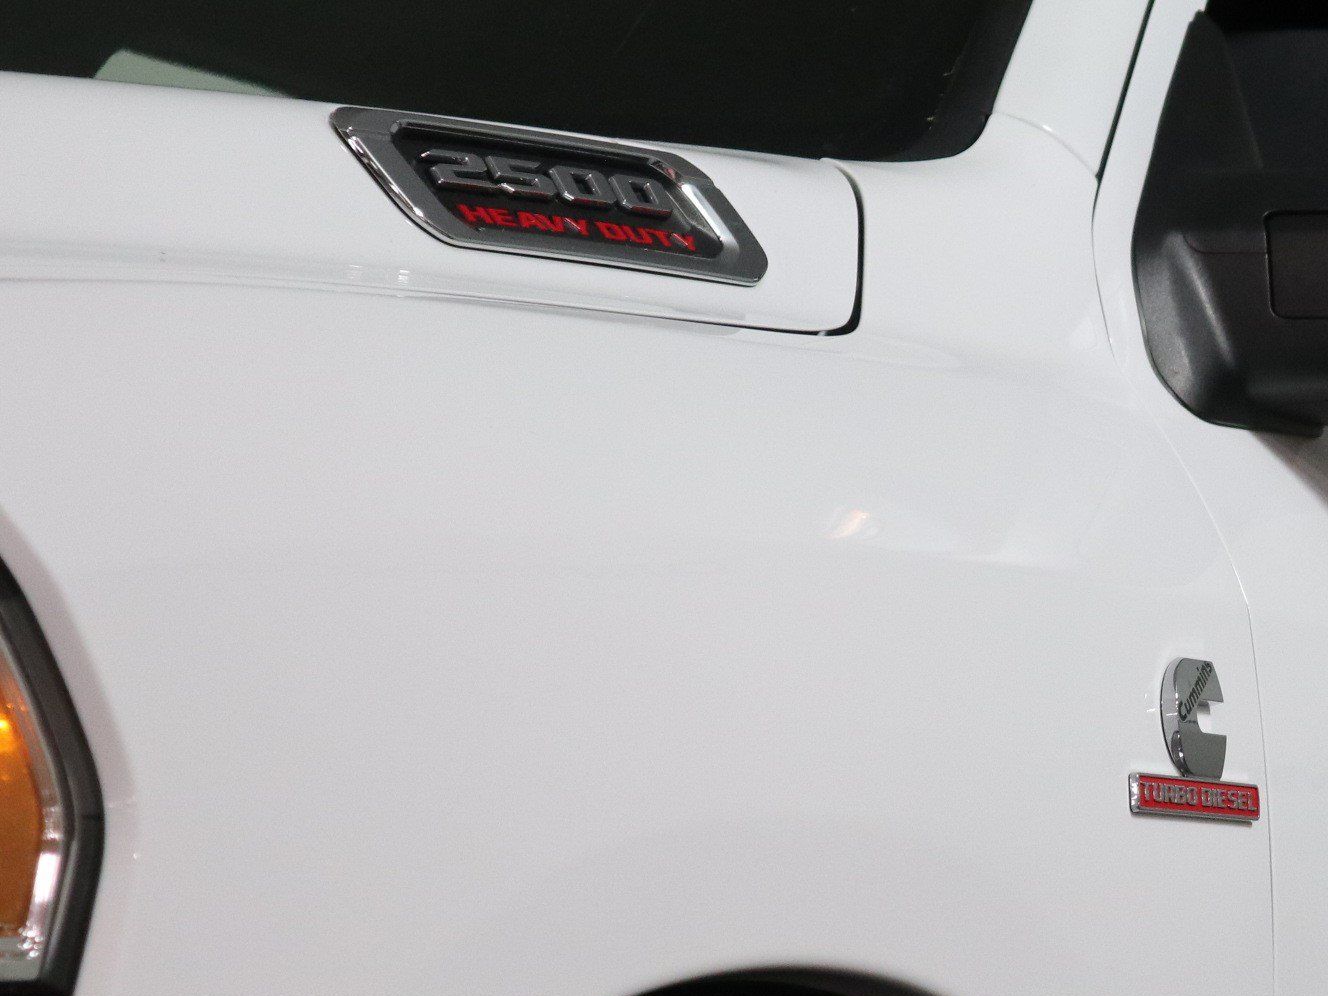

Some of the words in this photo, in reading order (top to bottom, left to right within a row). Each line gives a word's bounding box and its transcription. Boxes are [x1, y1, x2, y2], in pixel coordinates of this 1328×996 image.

[419, 149, 673, 219] 2500
[457, 204, 590, 237] HEAVY
[595, 221, 696, 251] DUTY
[1178, 660, 1213, 721] Cummins
[1140, 781, 1198, 806] TURBO
[1200, 787, 1258, 811] DIESEL
